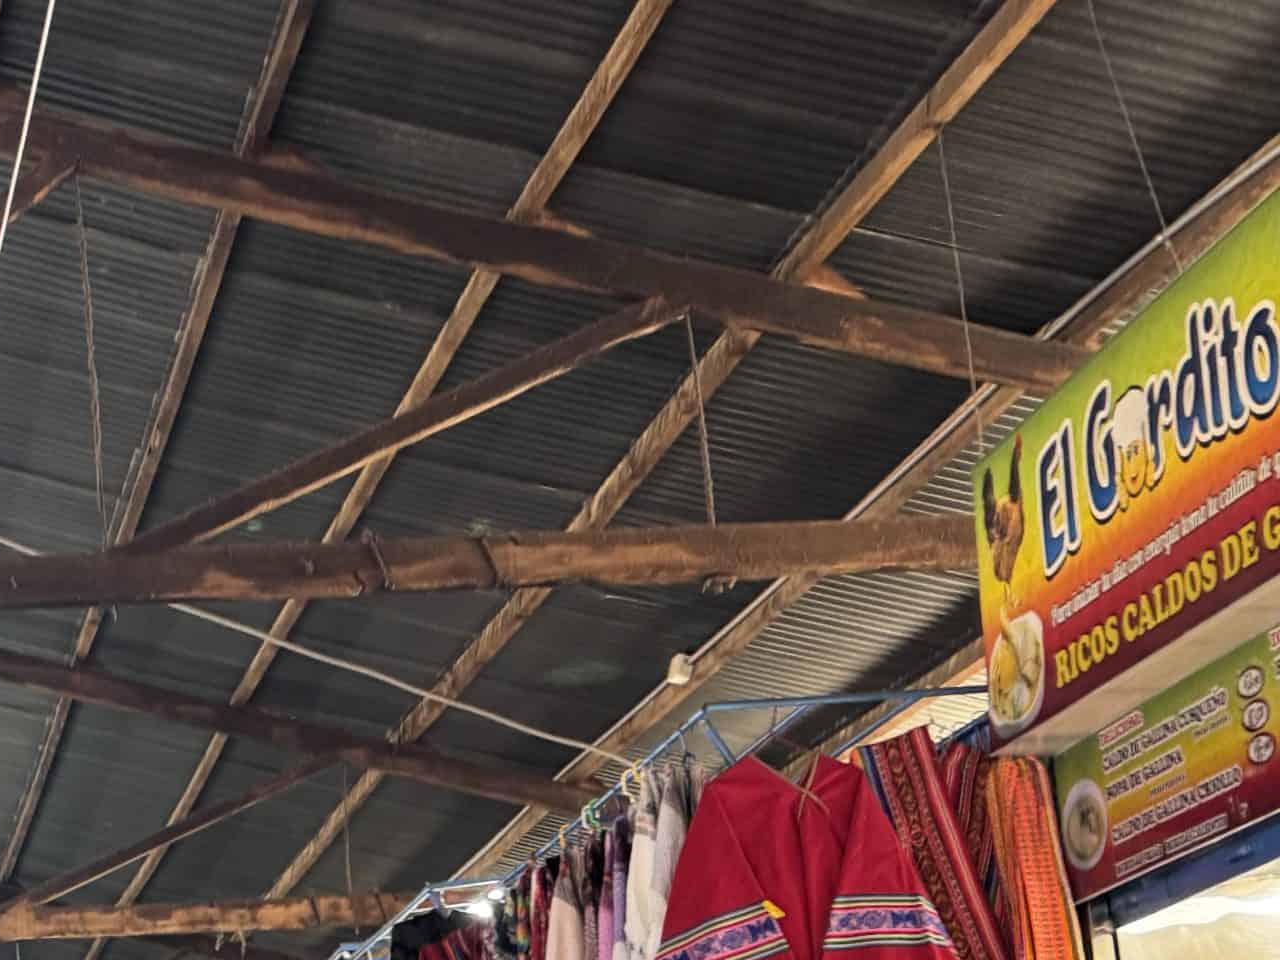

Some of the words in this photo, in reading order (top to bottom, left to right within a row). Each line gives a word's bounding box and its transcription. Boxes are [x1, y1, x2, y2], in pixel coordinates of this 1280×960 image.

[1036, 418, 1082, 578] El
[1055, 617, 1118, 688] RICOS
[1121, 550, 1217, 642] CALDOS
[1221, 521, 1259, 581] DE
